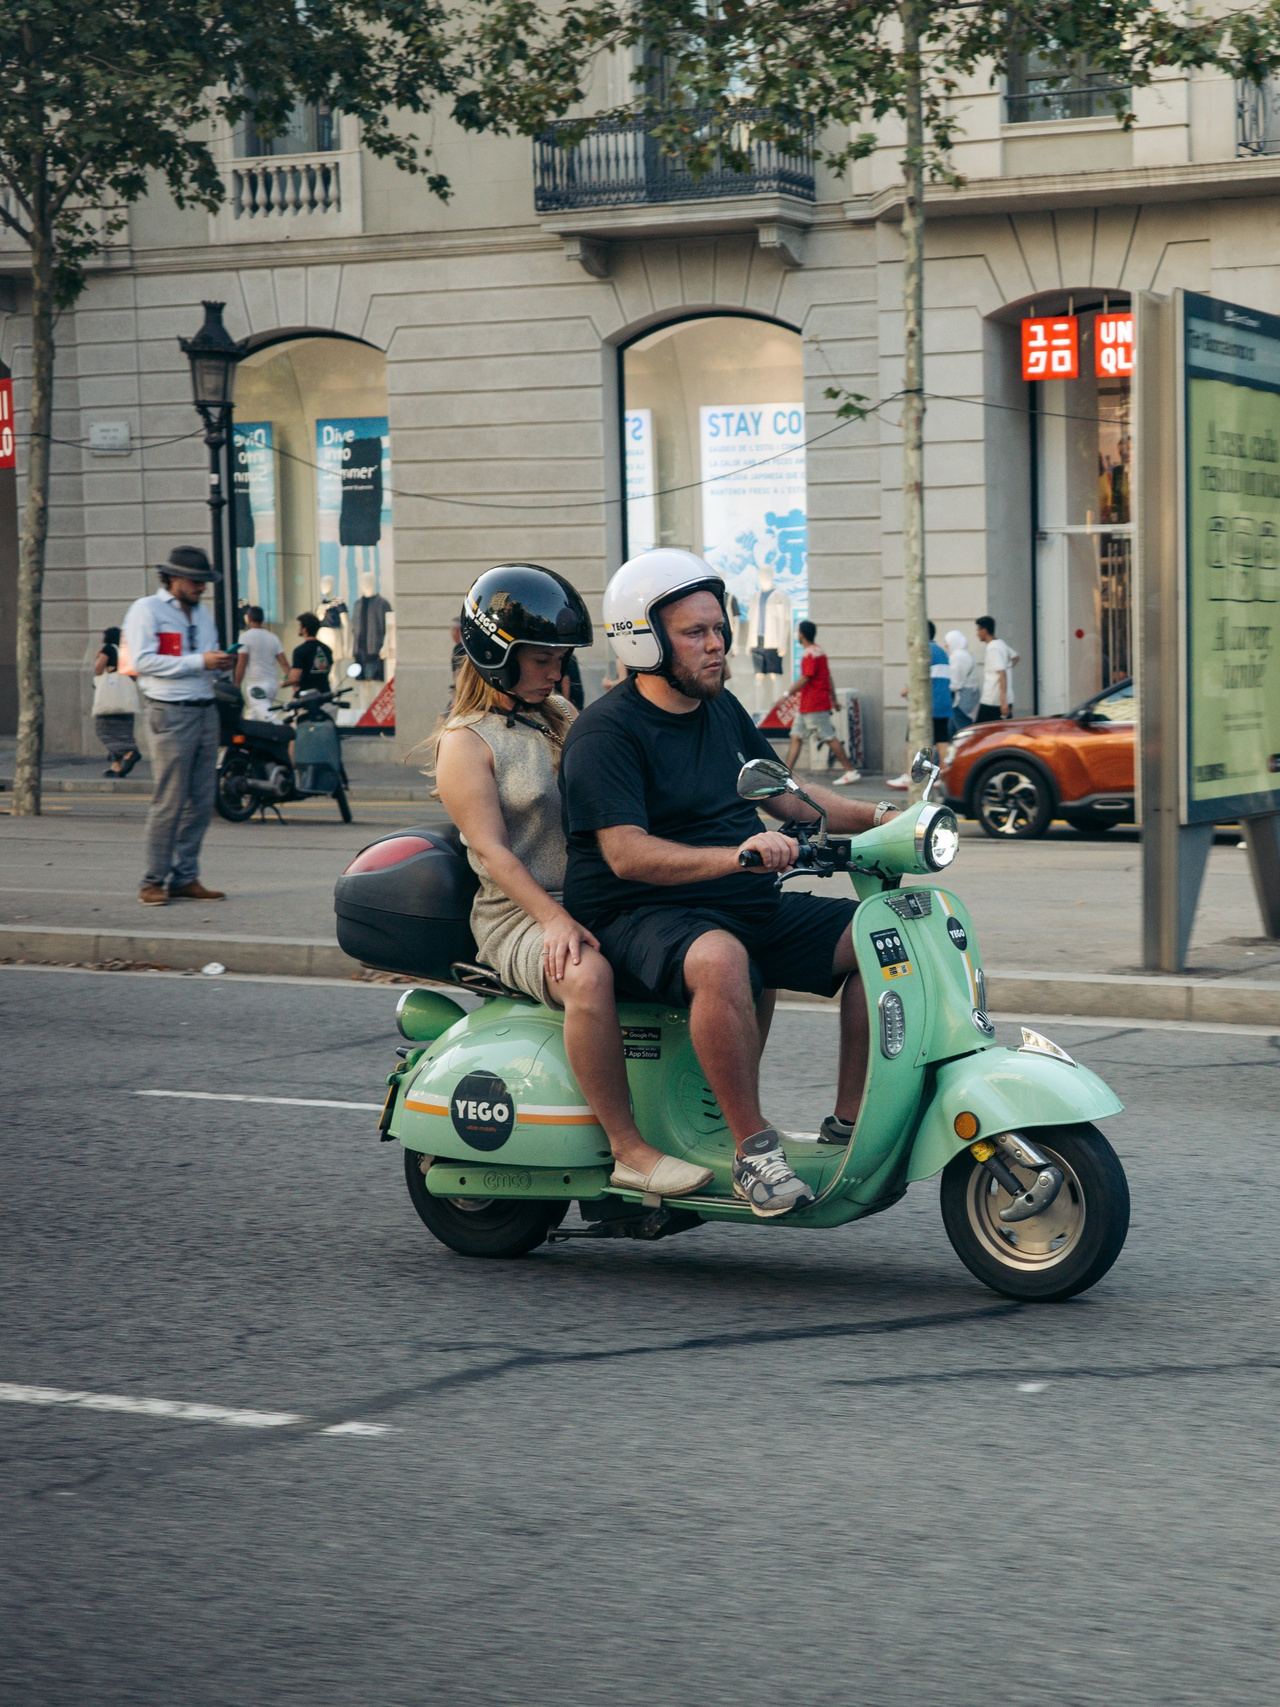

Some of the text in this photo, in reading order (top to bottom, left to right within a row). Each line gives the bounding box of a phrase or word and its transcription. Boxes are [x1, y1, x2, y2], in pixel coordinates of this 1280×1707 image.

[1028, 323, 1071, 347] ユニ
[1027, 350, 1071, 373] クロ
[708, 410, 802, 437] STAY CO
[322, 425, 355, 446] Dive
[475, 608, 498, 633] YEGO
[611, 620, 633, 631] YEGO
[948, 928, 965, 939] YEGO
[629, 1031, 648, 1039] Google
[628, 1050, 658, 1058] App Store
[455, 1099, 510, 1123] YEGO
